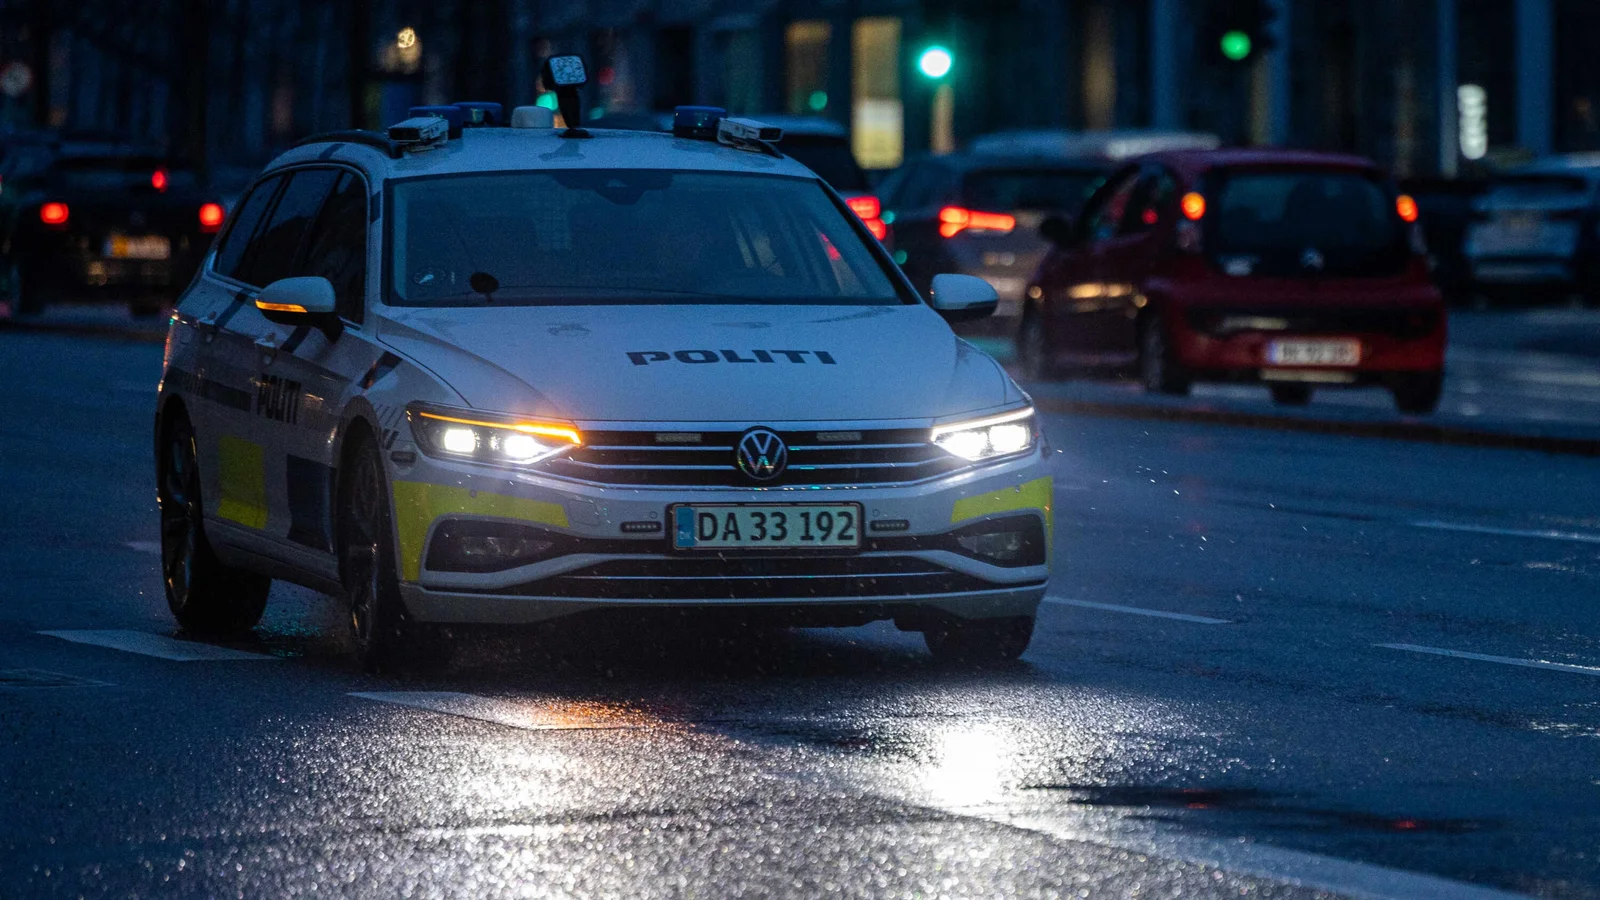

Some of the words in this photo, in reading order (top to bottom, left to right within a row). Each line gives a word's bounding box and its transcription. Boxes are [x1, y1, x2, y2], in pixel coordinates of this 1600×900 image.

[626, 349, 837, 366] POLITI
[257, 373, 302, 425] POLITI
[698, 511, 741, 541] DA
[750, 511, 788, 541] 33
[800, 511, 854, 541] 192
